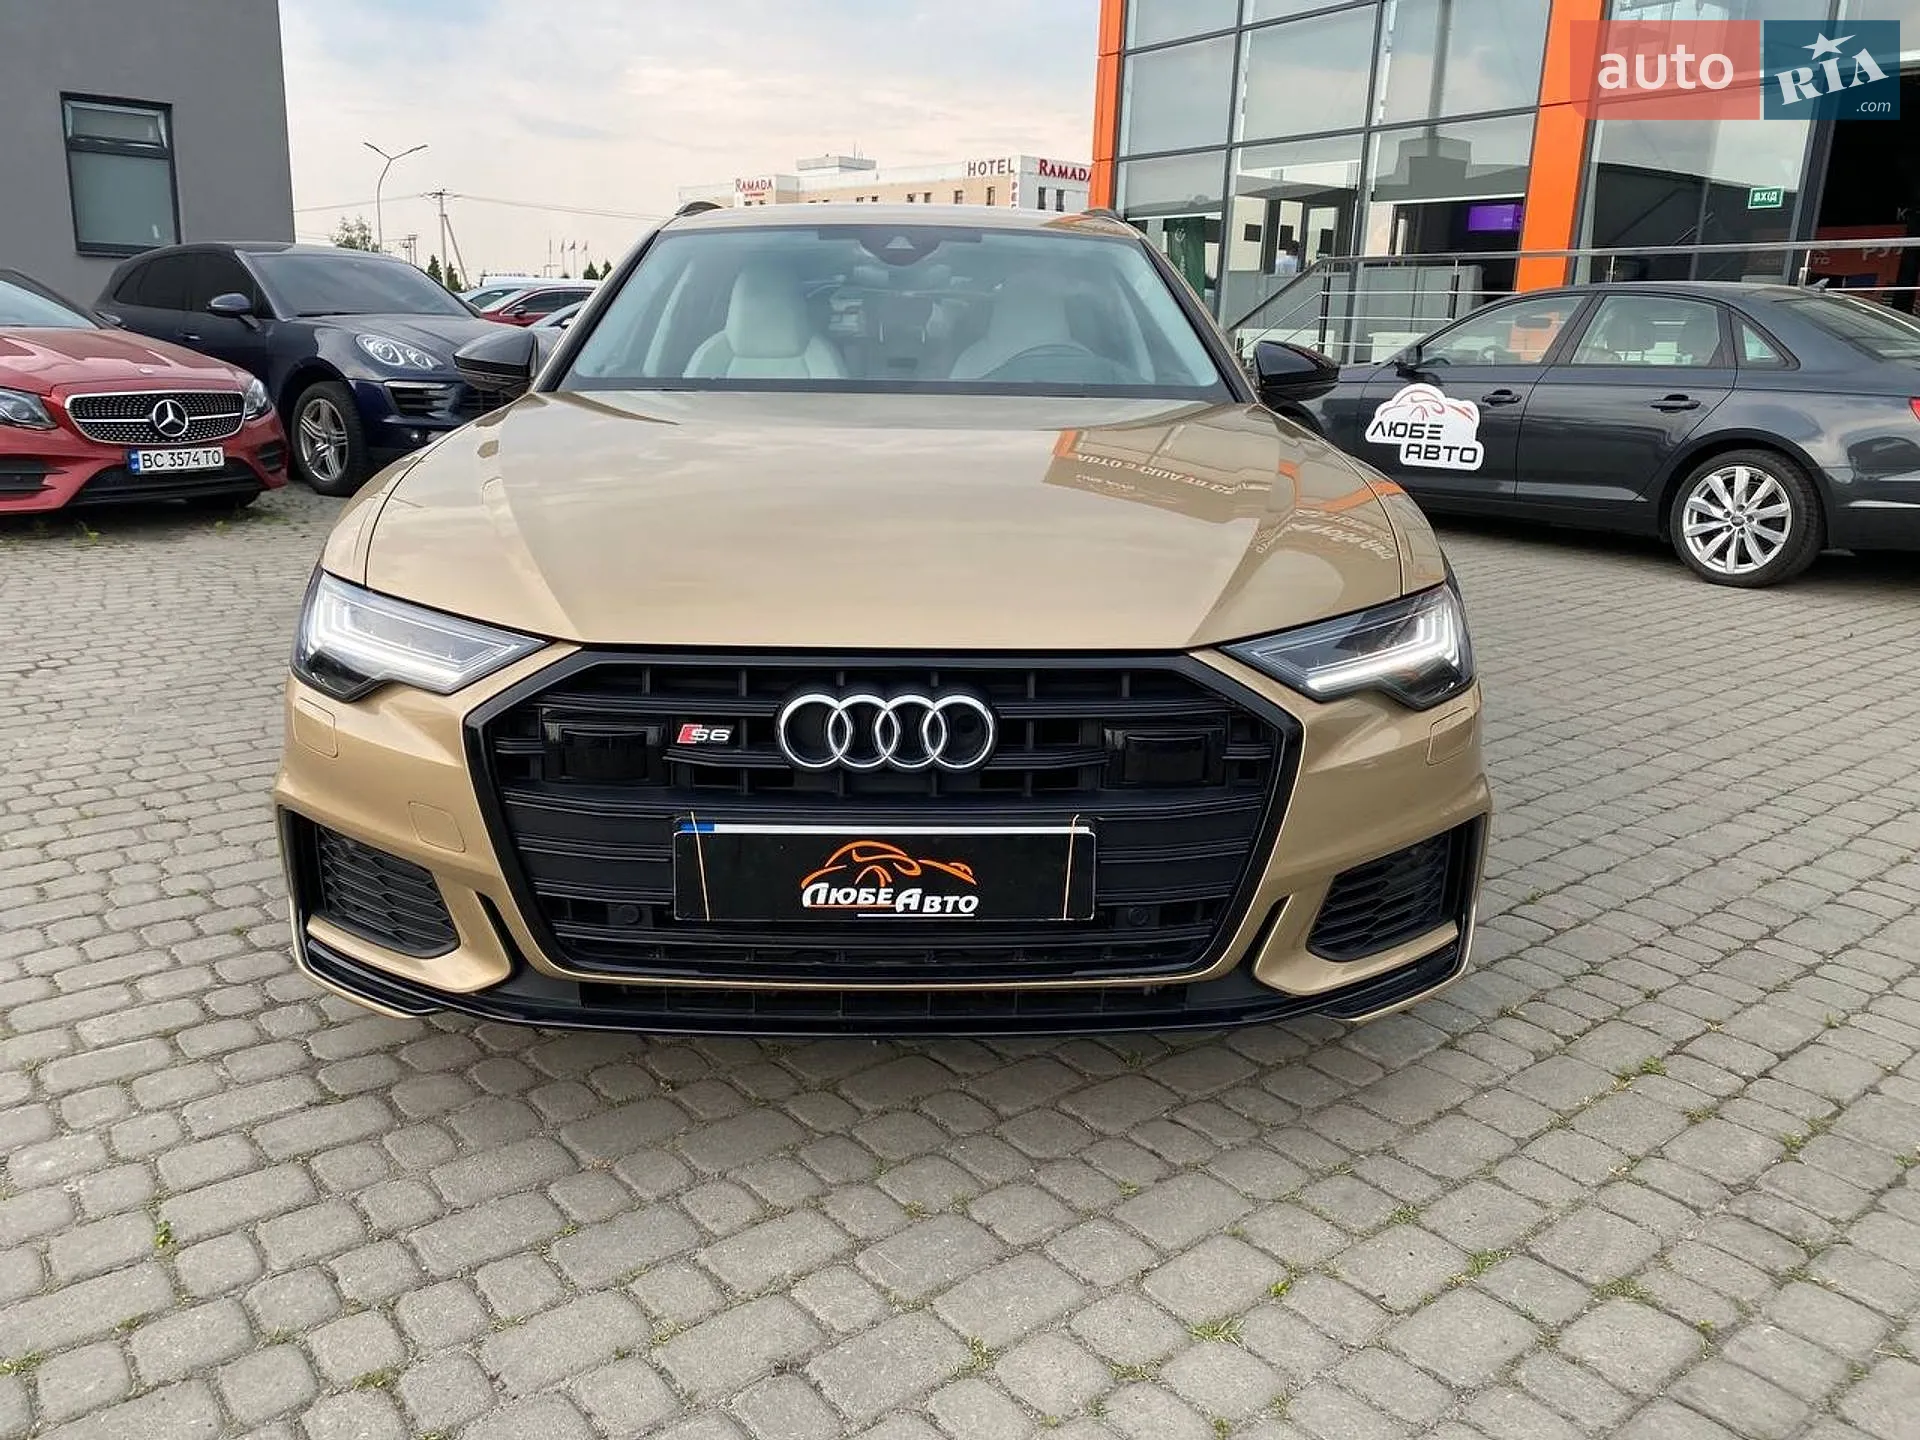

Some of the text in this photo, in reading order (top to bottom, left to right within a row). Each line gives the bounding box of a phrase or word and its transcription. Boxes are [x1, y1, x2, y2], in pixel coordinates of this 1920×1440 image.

[967, 159, 1014, 176] HOTEL
[735, 178, 774, 192] RAMADA
[1371, 421, 1444, 440] ЛЮБЕ
[142, 450, 221, 468] BC 3574 TO
[1405, 443, 1478, 463] АВТО
[691, 728, 731, 741] S6
